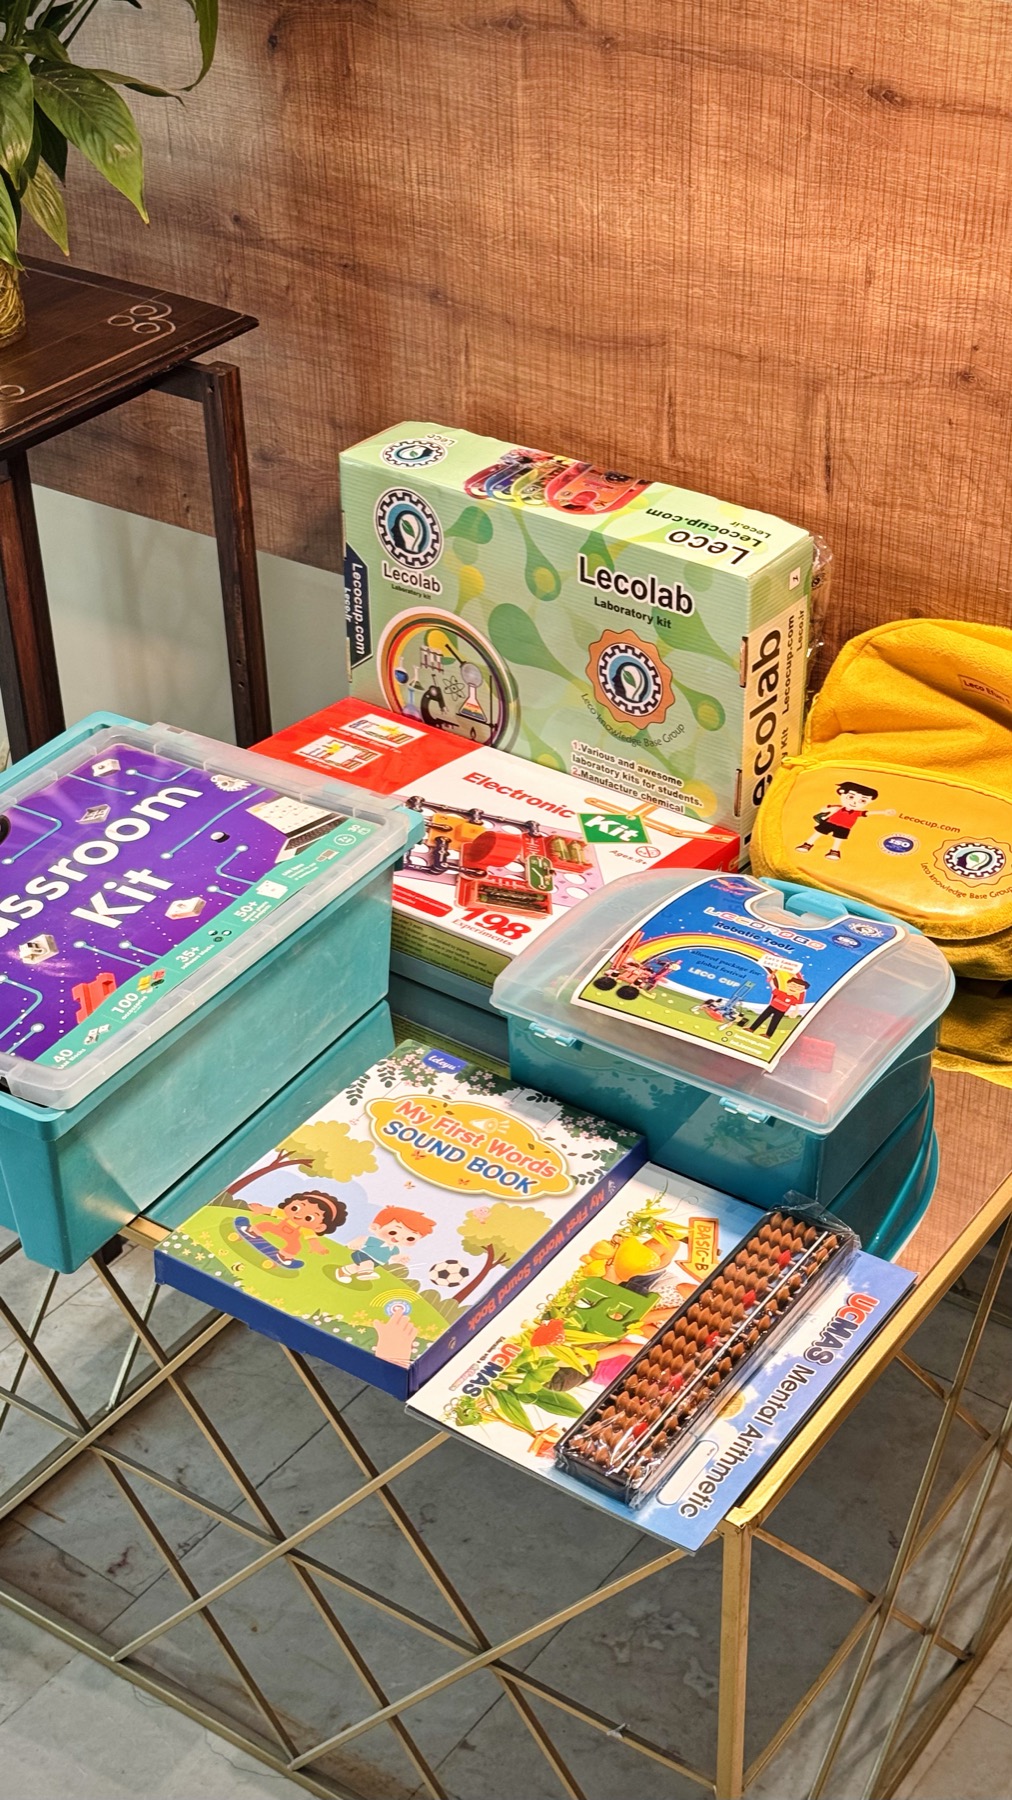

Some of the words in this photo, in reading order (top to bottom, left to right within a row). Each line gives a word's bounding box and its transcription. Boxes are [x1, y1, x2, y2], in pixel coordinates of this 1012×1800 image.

[646, 508, 763, 548] Lecocup.com
[668, 530, 750, 565] Leco
[383, 562, 441, 593] Lecolab
[579, 556, 693, 615] Lecolab
[352, 563, 365, 655] Lecocup.com
[594, 596, 653, 625] Laboratory
[656, 615, 672, 629] kit
[782, 614, 795, 714] Lecocup.com
[644, 738, 662, 748] Base
[662, 723, 685, 743] Group
[744, 629, 781, 845] ecolab
[572, 754, 620, 778] laboratory
[622, 771, 640, 784] kits
[642, 779, 656, 790] for
[658, 785, 702, 807] students.
[618, 759, 635, 770] and
[637, 765, 683, 787] awesome
[462, 771, 576, 819] Electronic
[641, 792, 684, 813] chemical
[583, 815, 640, 842] Kit
[899, 813, 961, 833] Lecocup.com
[70, 868, 174, 929] Kit
[929, 874, 967, 899] knowledge
[969, 892, 988, 900] Base
[452, 918, 513, 946] Experiments
[461, 907, 531, 940] 198
[688, 967, 716, 980] LECO
[718, 977, 741, 988] CUP
[690, 950, 719, 962] allowed
[719, 959, 749, 973] package
[749, 969, 762, 977] for
[696, 960, 719, 970] global
[720, 966, 747, 979] festival
[111, 992, 139, 1014] 100
[53, 1049, 74, 1063] 40
[395, 1101, 436, 1124] My
[433, 1117, 487, 1148] First
[486, 1138, 559, 1178] Words
[383, 1121, 466, 1163] SOUND
[467, 1156, 539, 1195] BOOK
[590, 1189, 605, 1210] My
[566, 1207, 588, 1234] First
[533, 1230, 565, 1267] Words
[695, 1223, 711, 1272] BASIC-B
[497, 1264, 531, 1304] Sound
[468, 1298, 496, 1331] Book
[804, 1291, 880, 1367] UCMAS
[462, 1343, 523, 1397] UCMAS
[753, 1363, 815, 1427] Mental
[679, 1422, 764, 1520] Arithmetic
